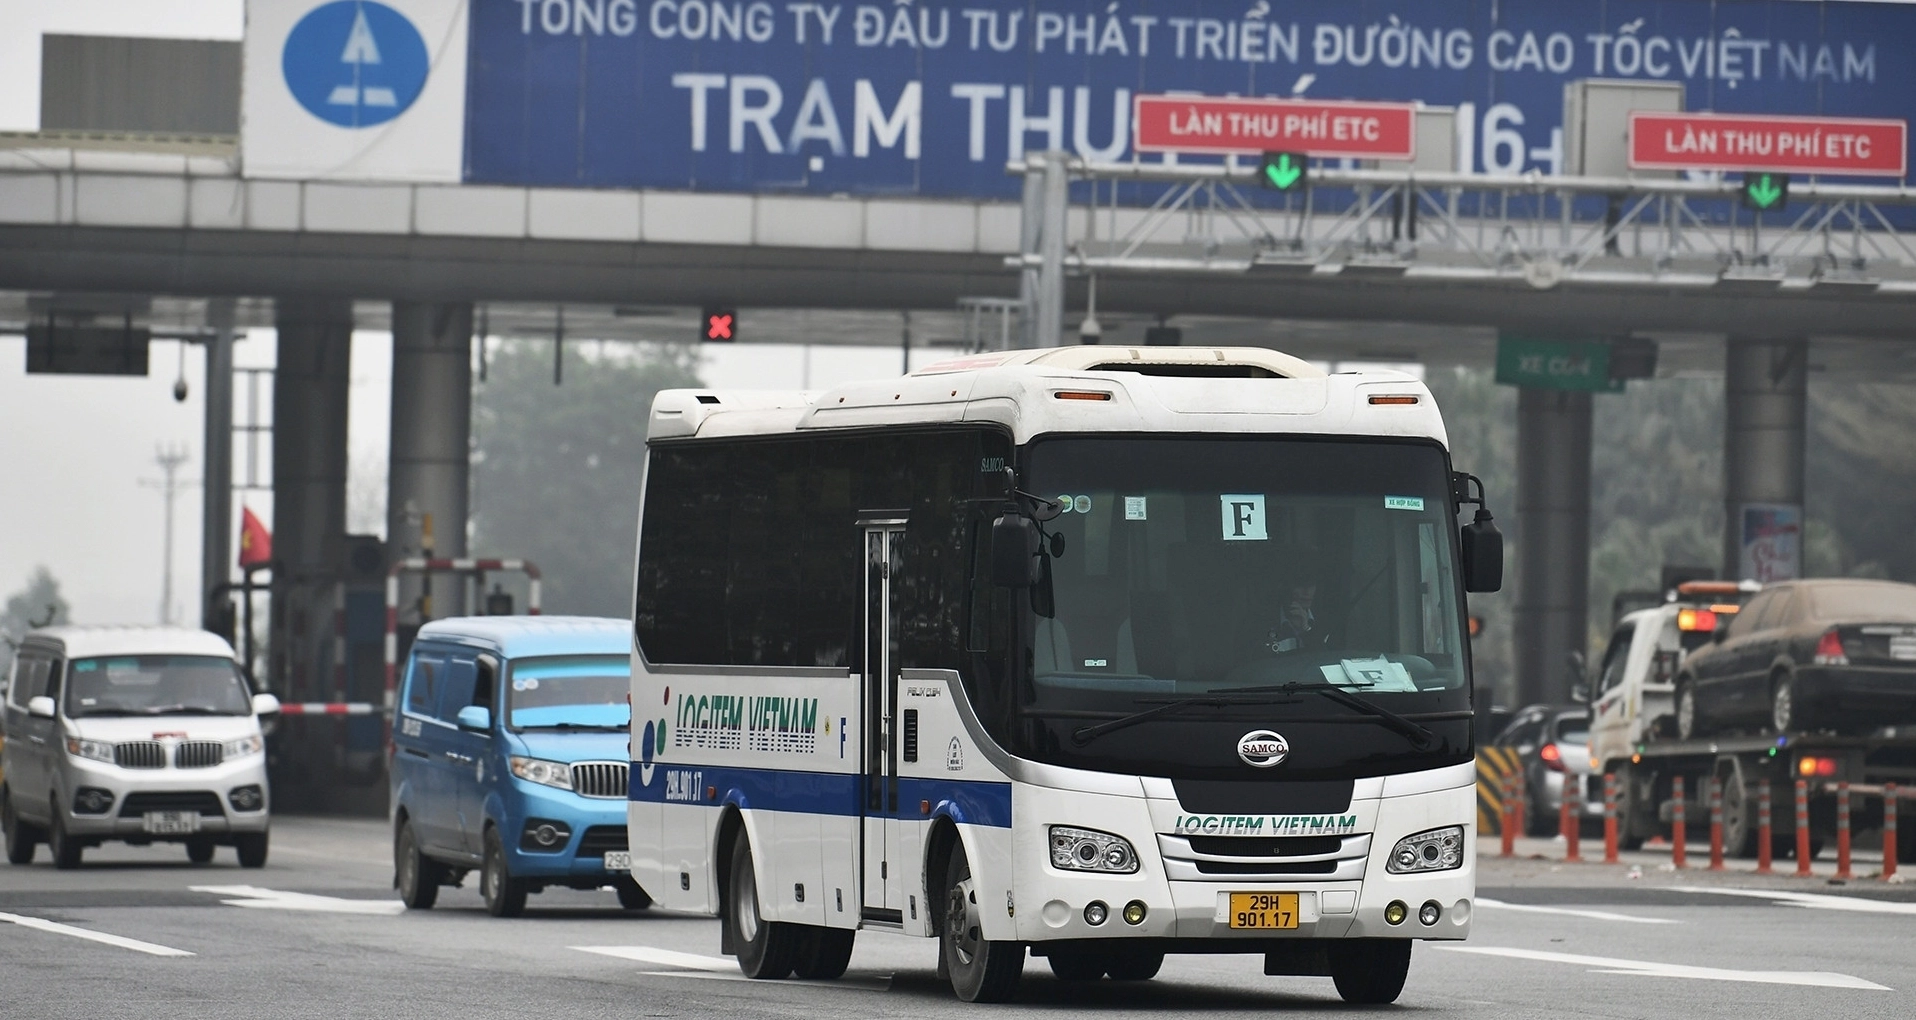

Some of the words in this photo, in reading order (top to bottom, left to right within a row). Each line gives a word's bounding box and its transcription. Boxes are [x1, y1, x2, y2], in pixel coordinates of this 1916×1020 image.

[786, 4, 841, 45] TY
[962, 9, 1024, 51] TƯ
[1035, 2, 1159, 57] PHÁT
[1168, 0, 1299, 63] TRIỂN
[1312, 14, 1473, 70] ĐƯỜNG
[1488, 30, 1574, 73] CAO
[1586, 18, 1671, 77] TỐC
[1676, 27, 1771, 89] VIỆT
[1778, 41, 1876, 83] NAM
[671, 73, 922, 172] TRẠM
[951, 83, 1130, 166] THU
[1169, 106, 1222, 136] LÀN
[1227, 112, 1280, 139] THU
[1284, 110, 1329, 140] PHÍ
[1333, 116, 1381, 142] ETC
[1665, 122, 1717, 155] LÀN
[1723, 130, 1773, 156] THU
[1777, 127, 1822, 158] PHÍ
[1826, 133, 1872, 159] ETC
[981, 457, 1005, 472] SAMCO
[1230, 502, 1255, 536] F
[675, 693, 744, 749] LOGITEM
[749, 697, 818, 754] VIETNAM
[839, 717, 847, 759] F
[1242, 743, 1285, 754] SAMCO
[1174, 815, 1264, 835] LOGITEM
[1271, 815, 1357, 835] VIETNAM
[1237, 912, 1291, 927] 901.17
[1249, 896, 1279, 910] 29H
